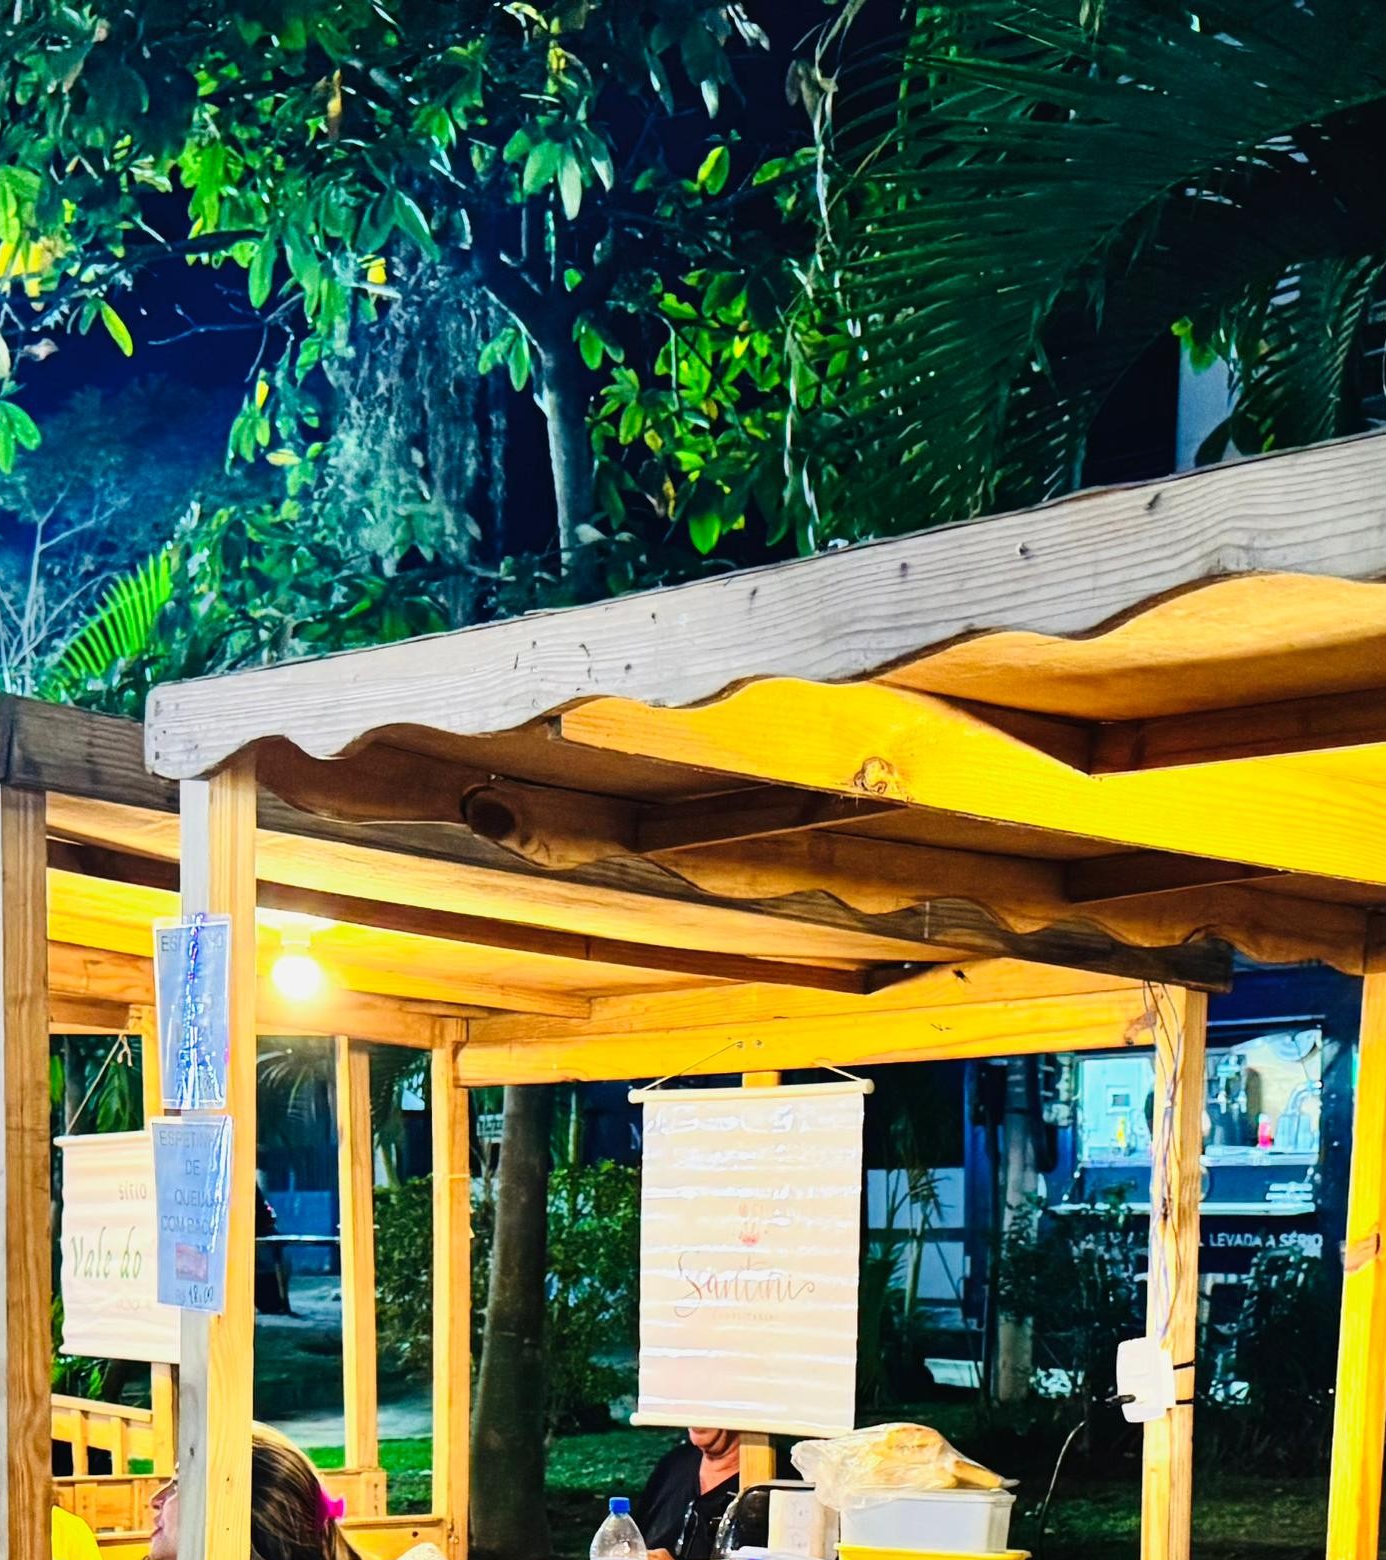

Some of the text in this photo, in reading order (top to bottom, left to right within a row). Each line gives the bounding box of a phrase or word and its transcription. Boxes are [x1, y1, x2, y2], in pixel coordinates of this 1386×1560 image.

[185, 1159, 201, 1176] DE
[1209, 1233, 1263, 1247] LEVADA
[1265, 1234, 1276, 1247] A
[70, 1226, 142, 1279] Vale do
